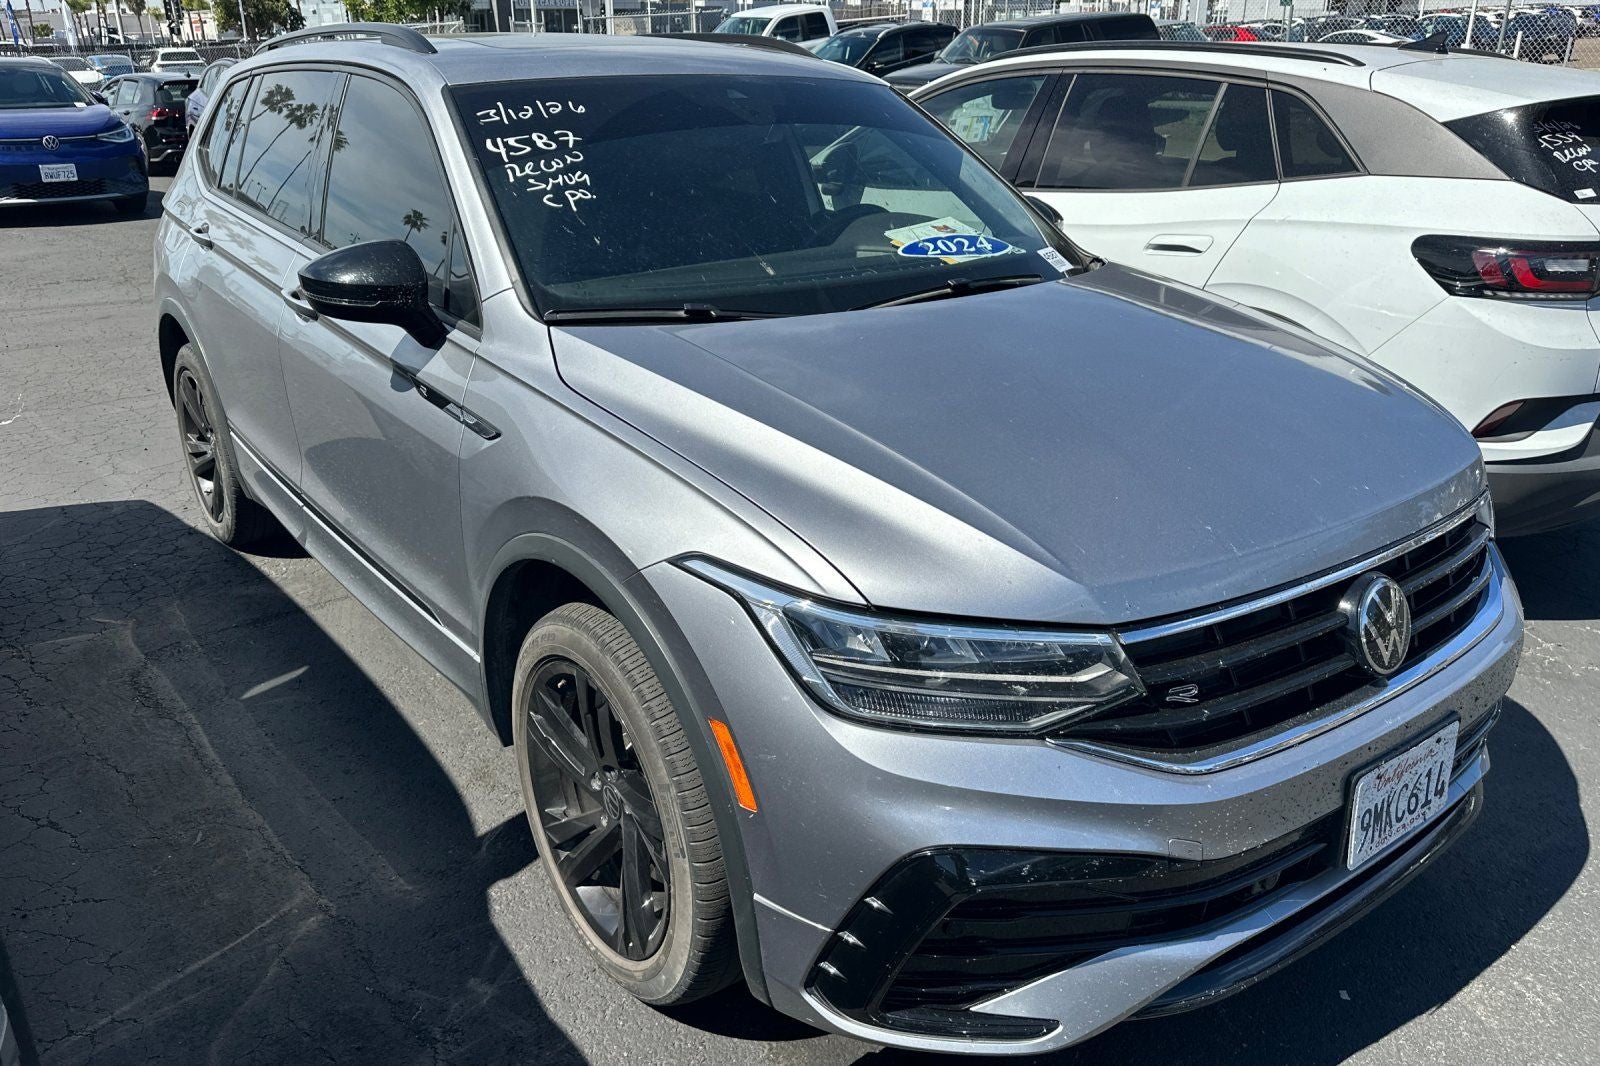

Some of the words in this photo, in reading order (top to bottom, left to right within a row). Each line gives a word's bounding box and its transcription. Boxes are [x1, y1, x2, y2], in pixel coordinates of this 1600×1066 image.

[476, 100, 585, 125] 3/12/26
[485, 130, 583, 162] 4587
[918, 234, 993, 255] 2024
[1357, 760, 1446, 854] 9MKC614
